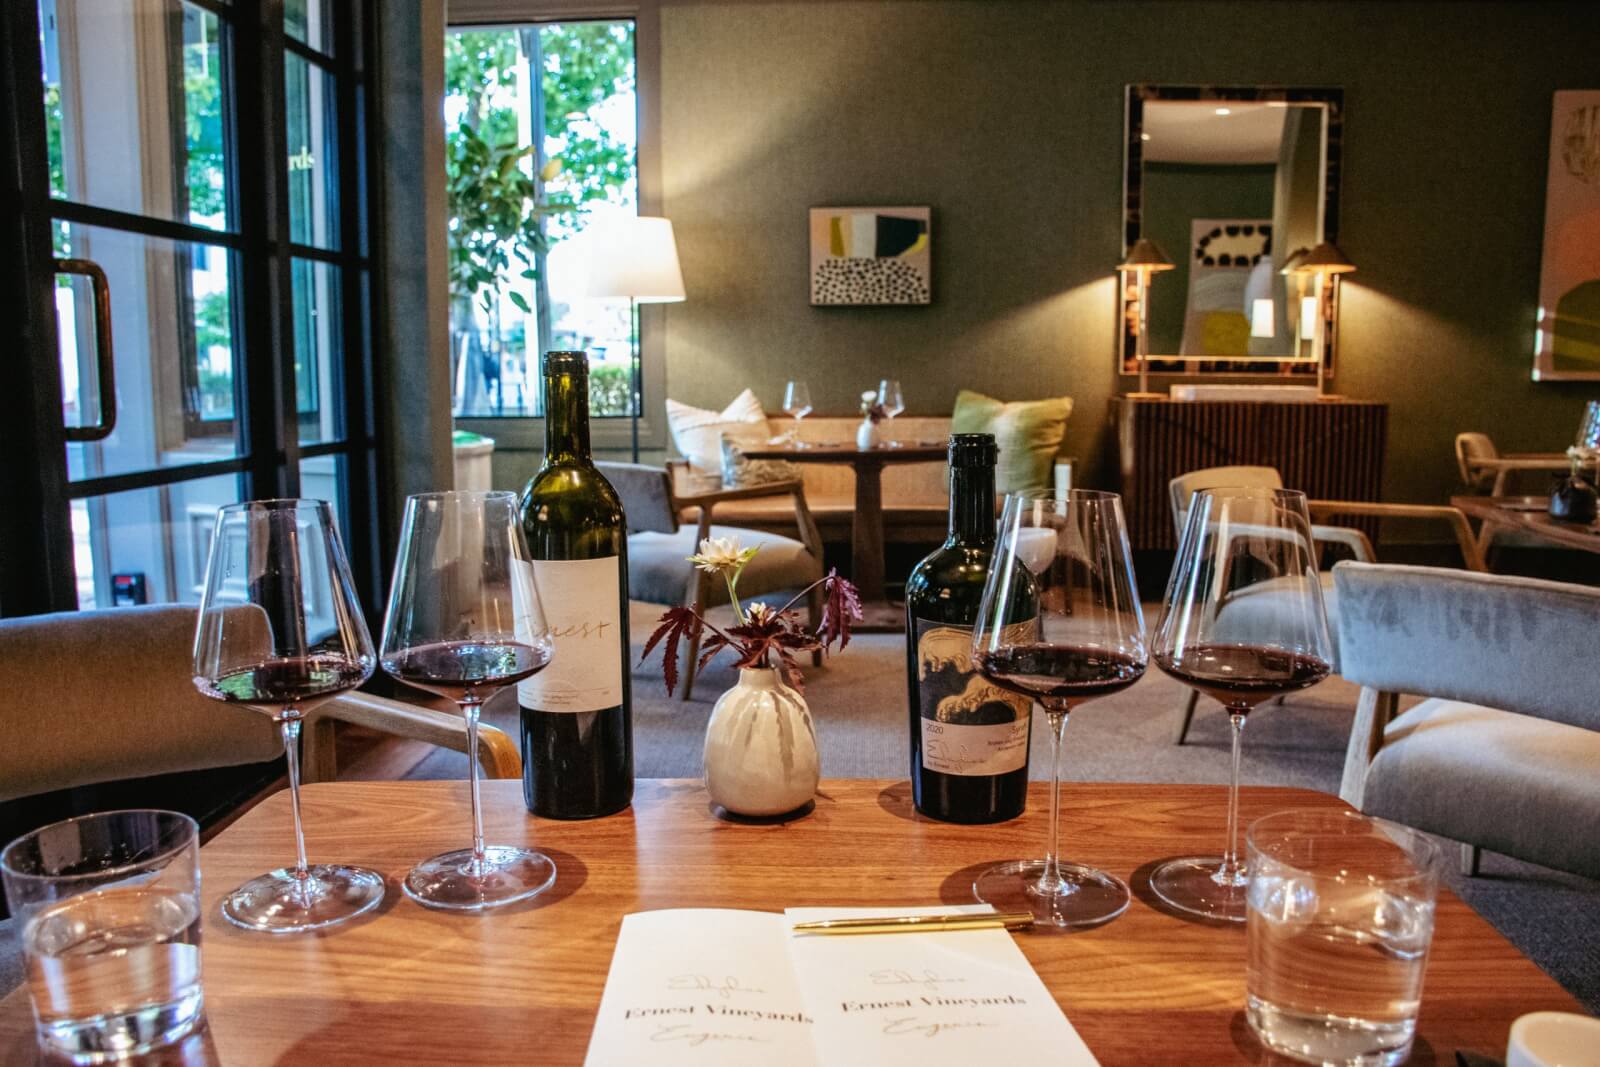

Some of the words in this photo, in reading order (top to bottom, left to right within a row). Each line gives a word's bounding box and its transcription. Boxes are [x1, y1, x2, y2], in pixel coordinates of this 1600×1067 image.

[842, 999, 912, 1012] Ernest
[920, 995, 1027, 1008] Vineyards
[625, 1005, 695, 1020] Ernest
[706, 1004, 815, 1024] Vineyards
